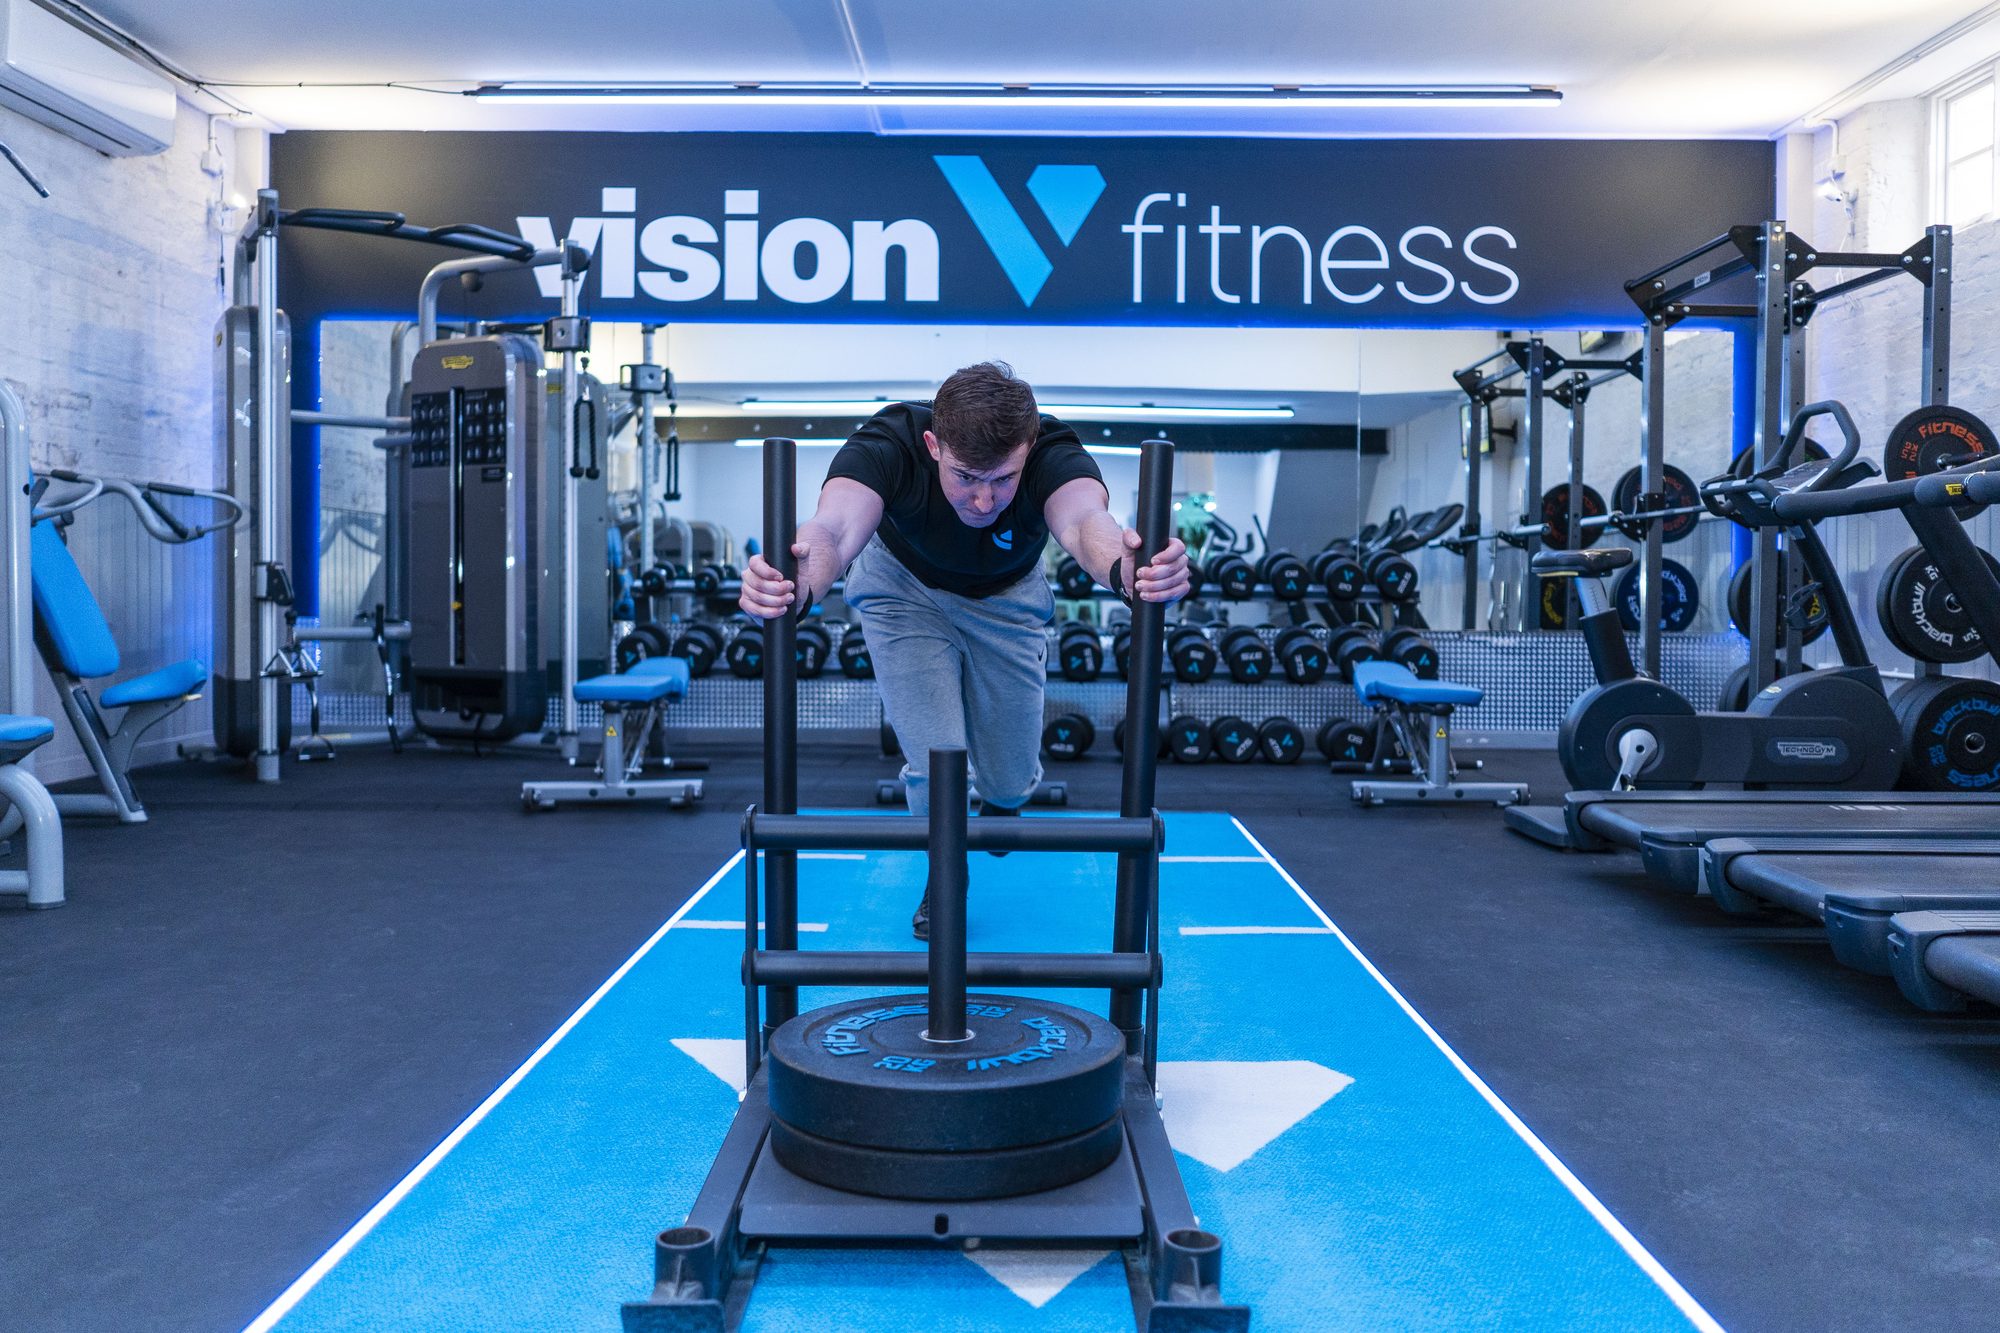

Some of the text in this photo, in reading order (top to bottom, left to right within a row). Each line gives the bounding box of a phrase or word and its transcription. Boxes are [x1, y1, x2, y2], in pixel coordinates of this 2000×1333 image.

[516, 187, 940, 304] vision
[1121, 192, 1520, 305] fitness
[1779, 743, 1835, 757] TECHNOGYM
[967, 1016, 1067, 1072] blackbull
